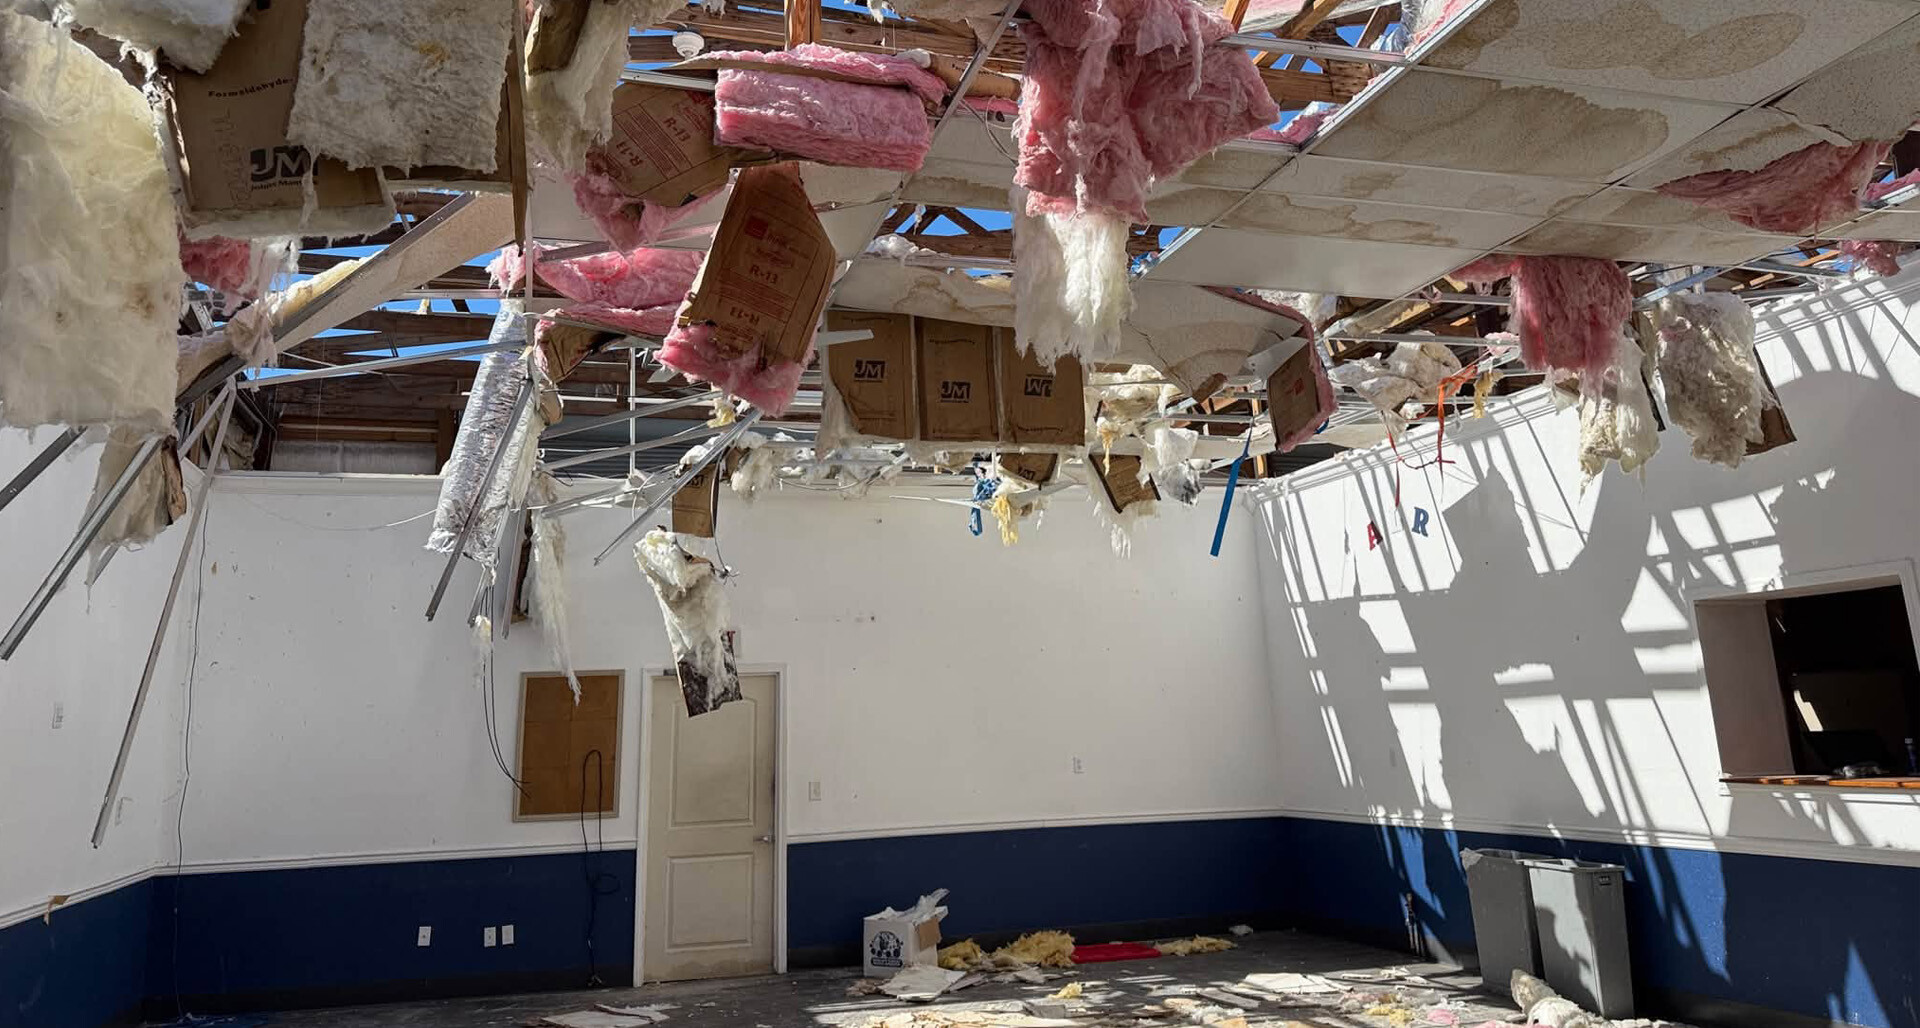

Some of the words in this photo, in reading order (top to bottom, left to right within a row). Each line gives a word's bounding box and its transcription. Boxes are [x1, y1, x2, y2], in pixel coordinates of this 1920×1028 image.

[663, 116, 692, 143] R-13
[250, 145, 317, 182] JM
[750, 265, 780, 284] R-13
[853, 359, 886, 379] JM
[940, 380, 972, 400] JM
[1024, 378, 1053, 397] JM
[1411, 506, 1430, 537] R
[1367, 520, 1384, 552] A
